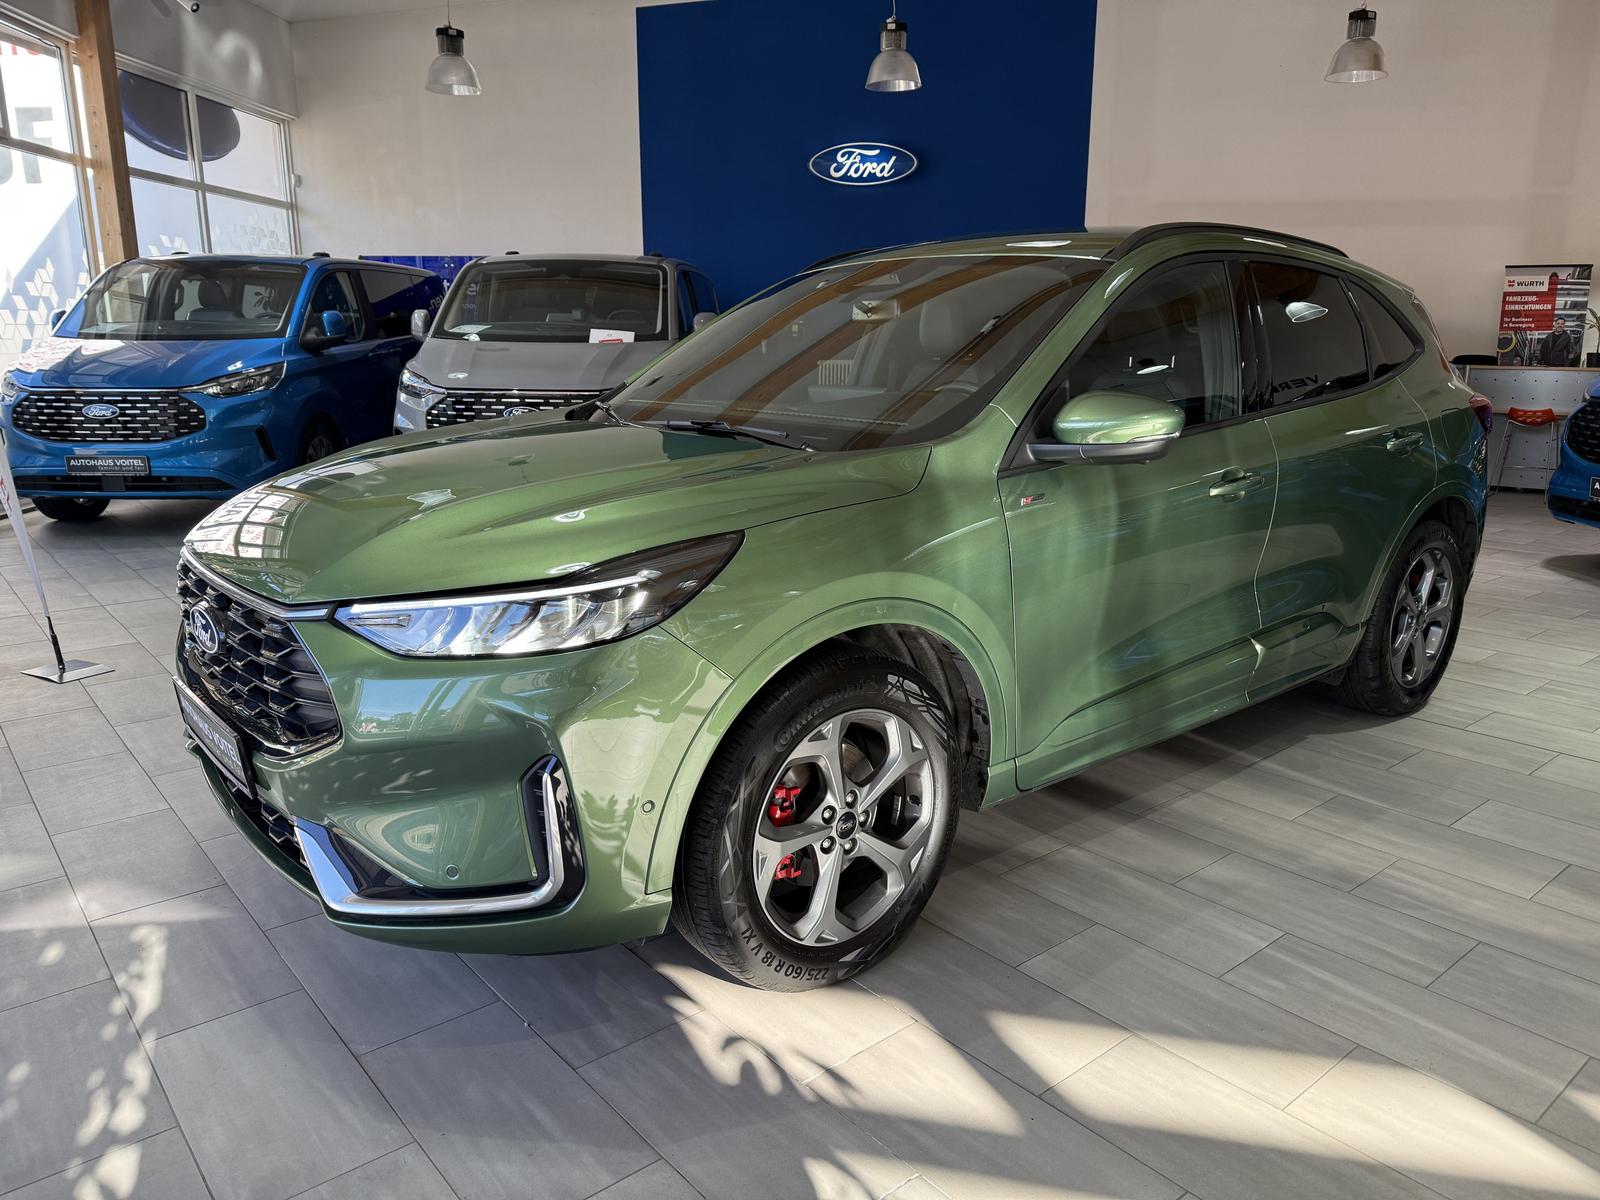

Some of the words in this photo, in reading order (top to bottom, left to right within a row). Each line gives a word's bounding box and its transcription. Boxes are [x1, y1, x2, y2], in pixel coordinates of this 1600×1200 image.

[829, 148, 897, 178] Ford
[88, 406, 113, 417] Ford
[193, 611, 213, 647] Ford
[750, 942, 764, 957] V
[761, 950, 776, 968] 18
[784, 963, 830, 981] 225/60
